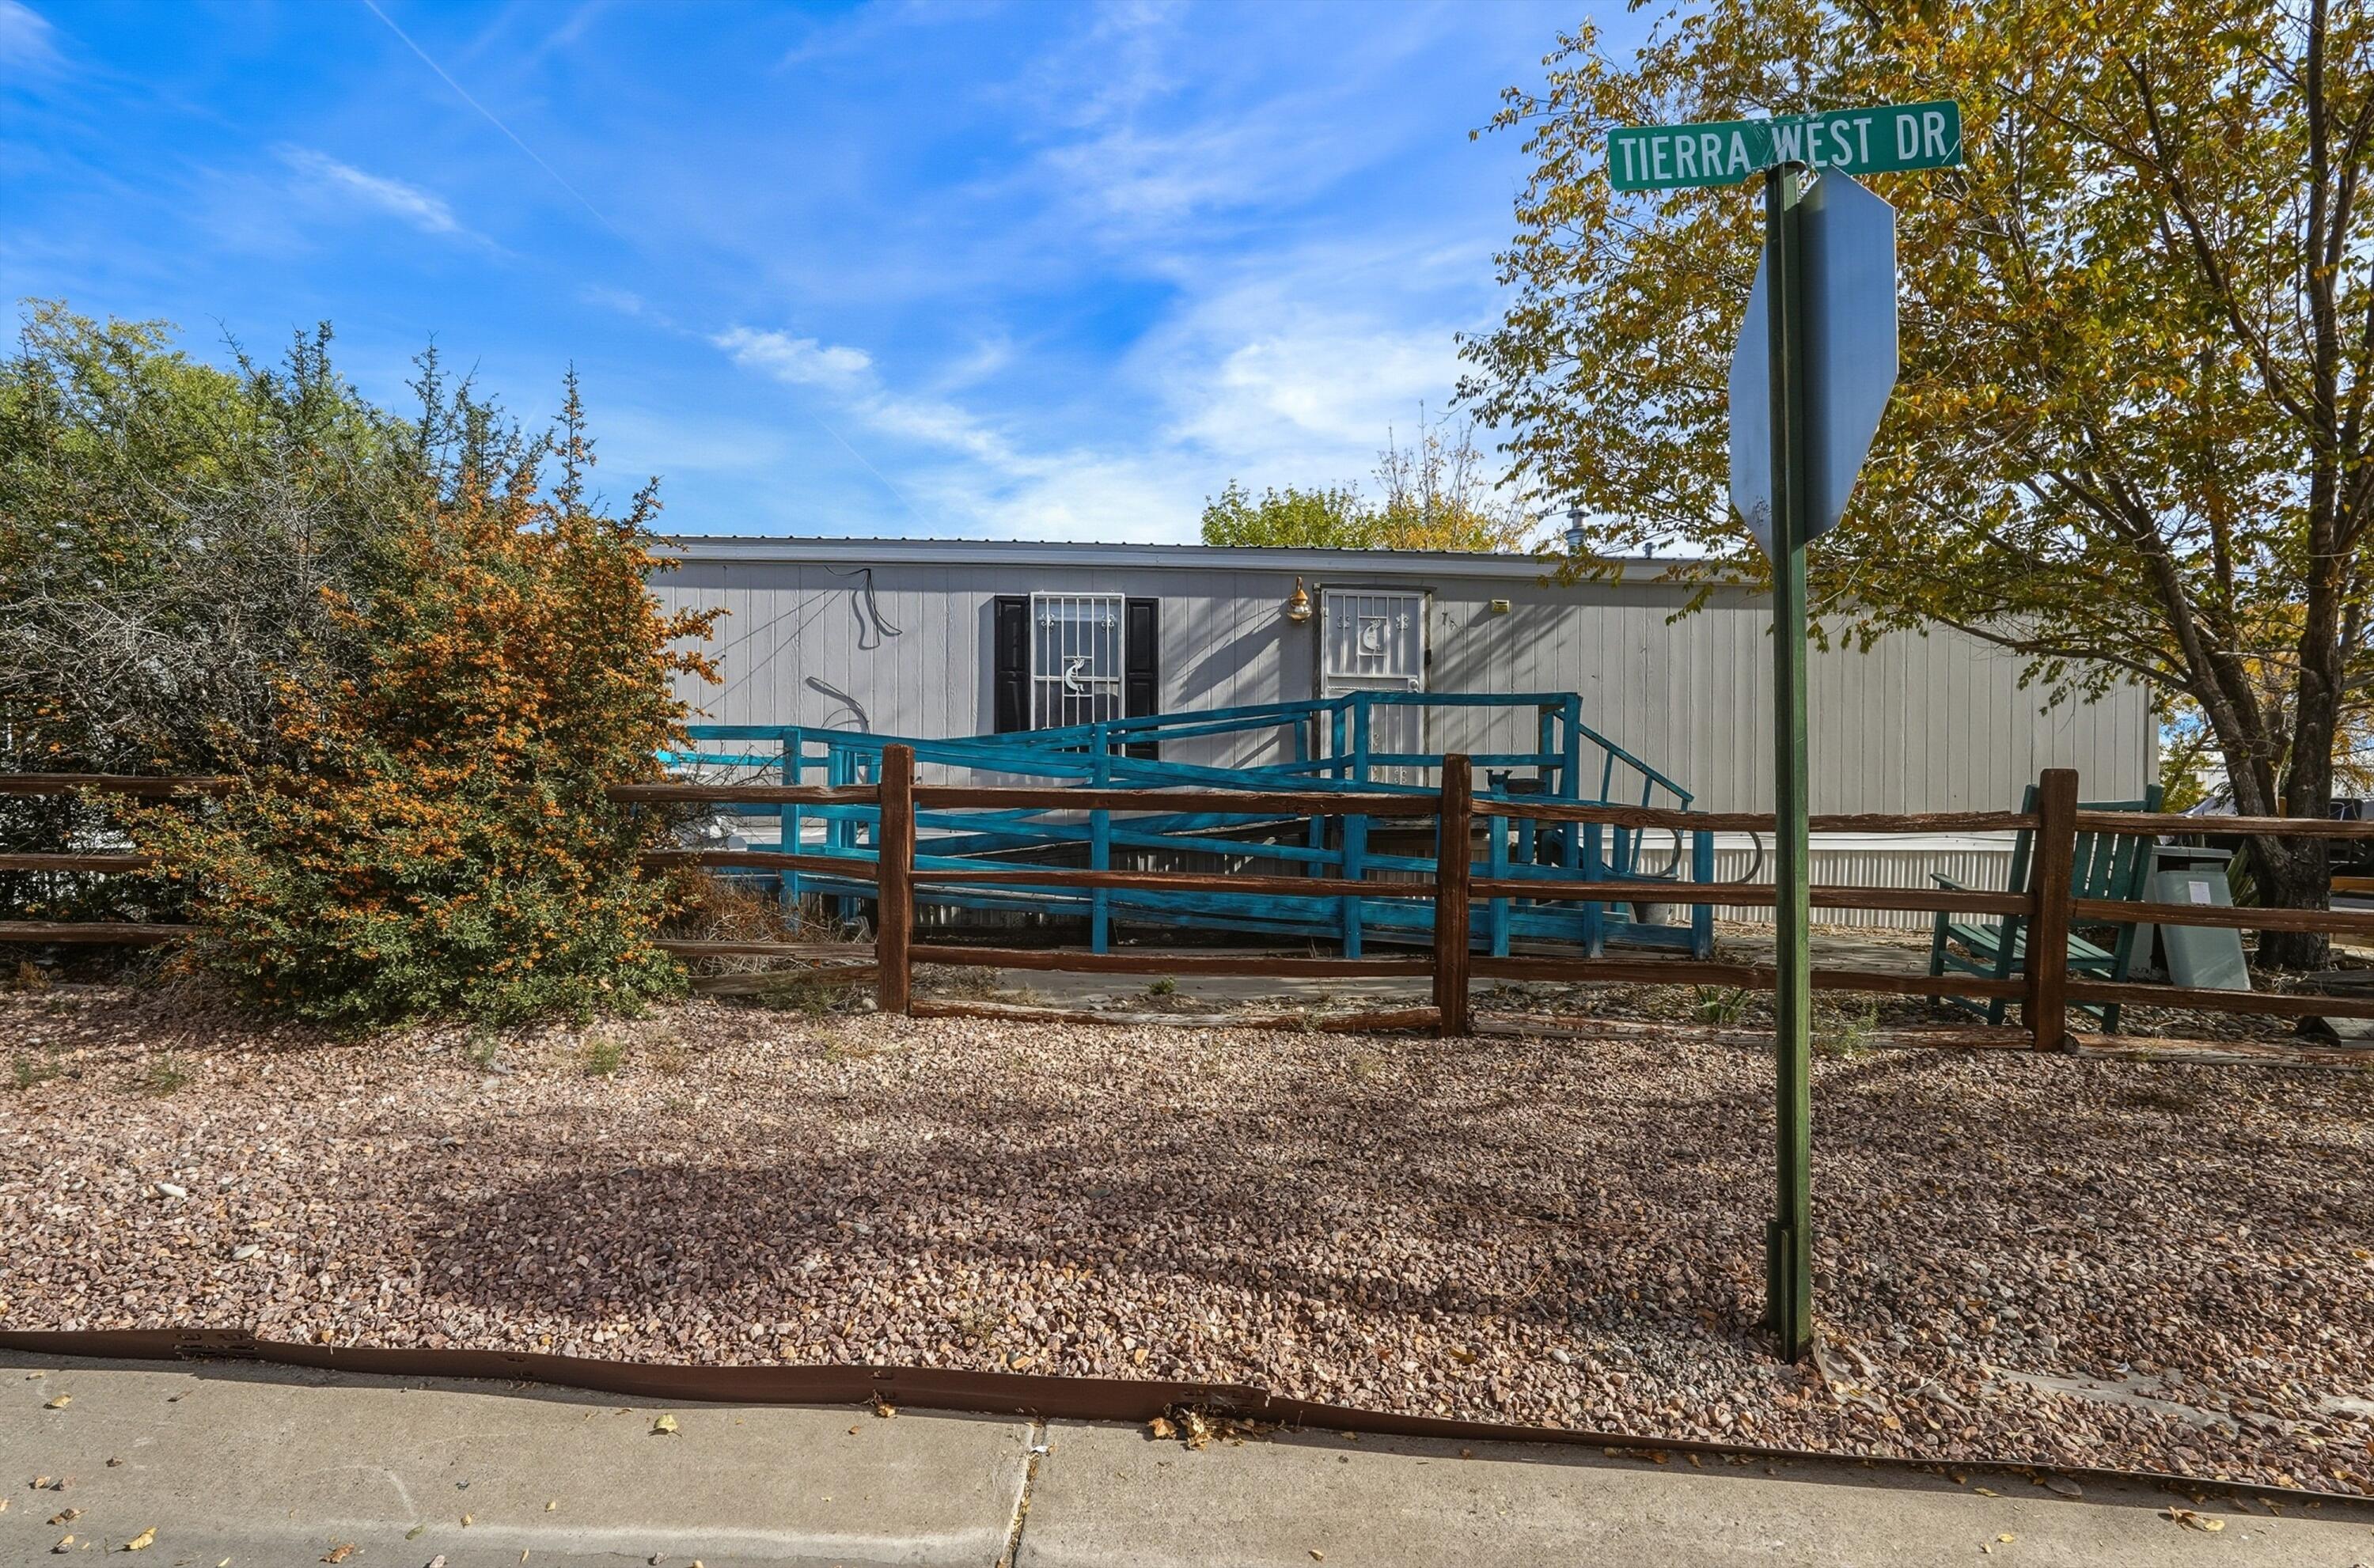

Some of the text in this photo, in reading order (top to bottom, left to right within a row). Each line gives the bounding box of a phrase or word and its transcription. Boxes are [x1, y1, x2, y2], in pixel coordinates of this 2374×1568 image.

[1618, 112, 1947, 181] TIERRA WEST DR
